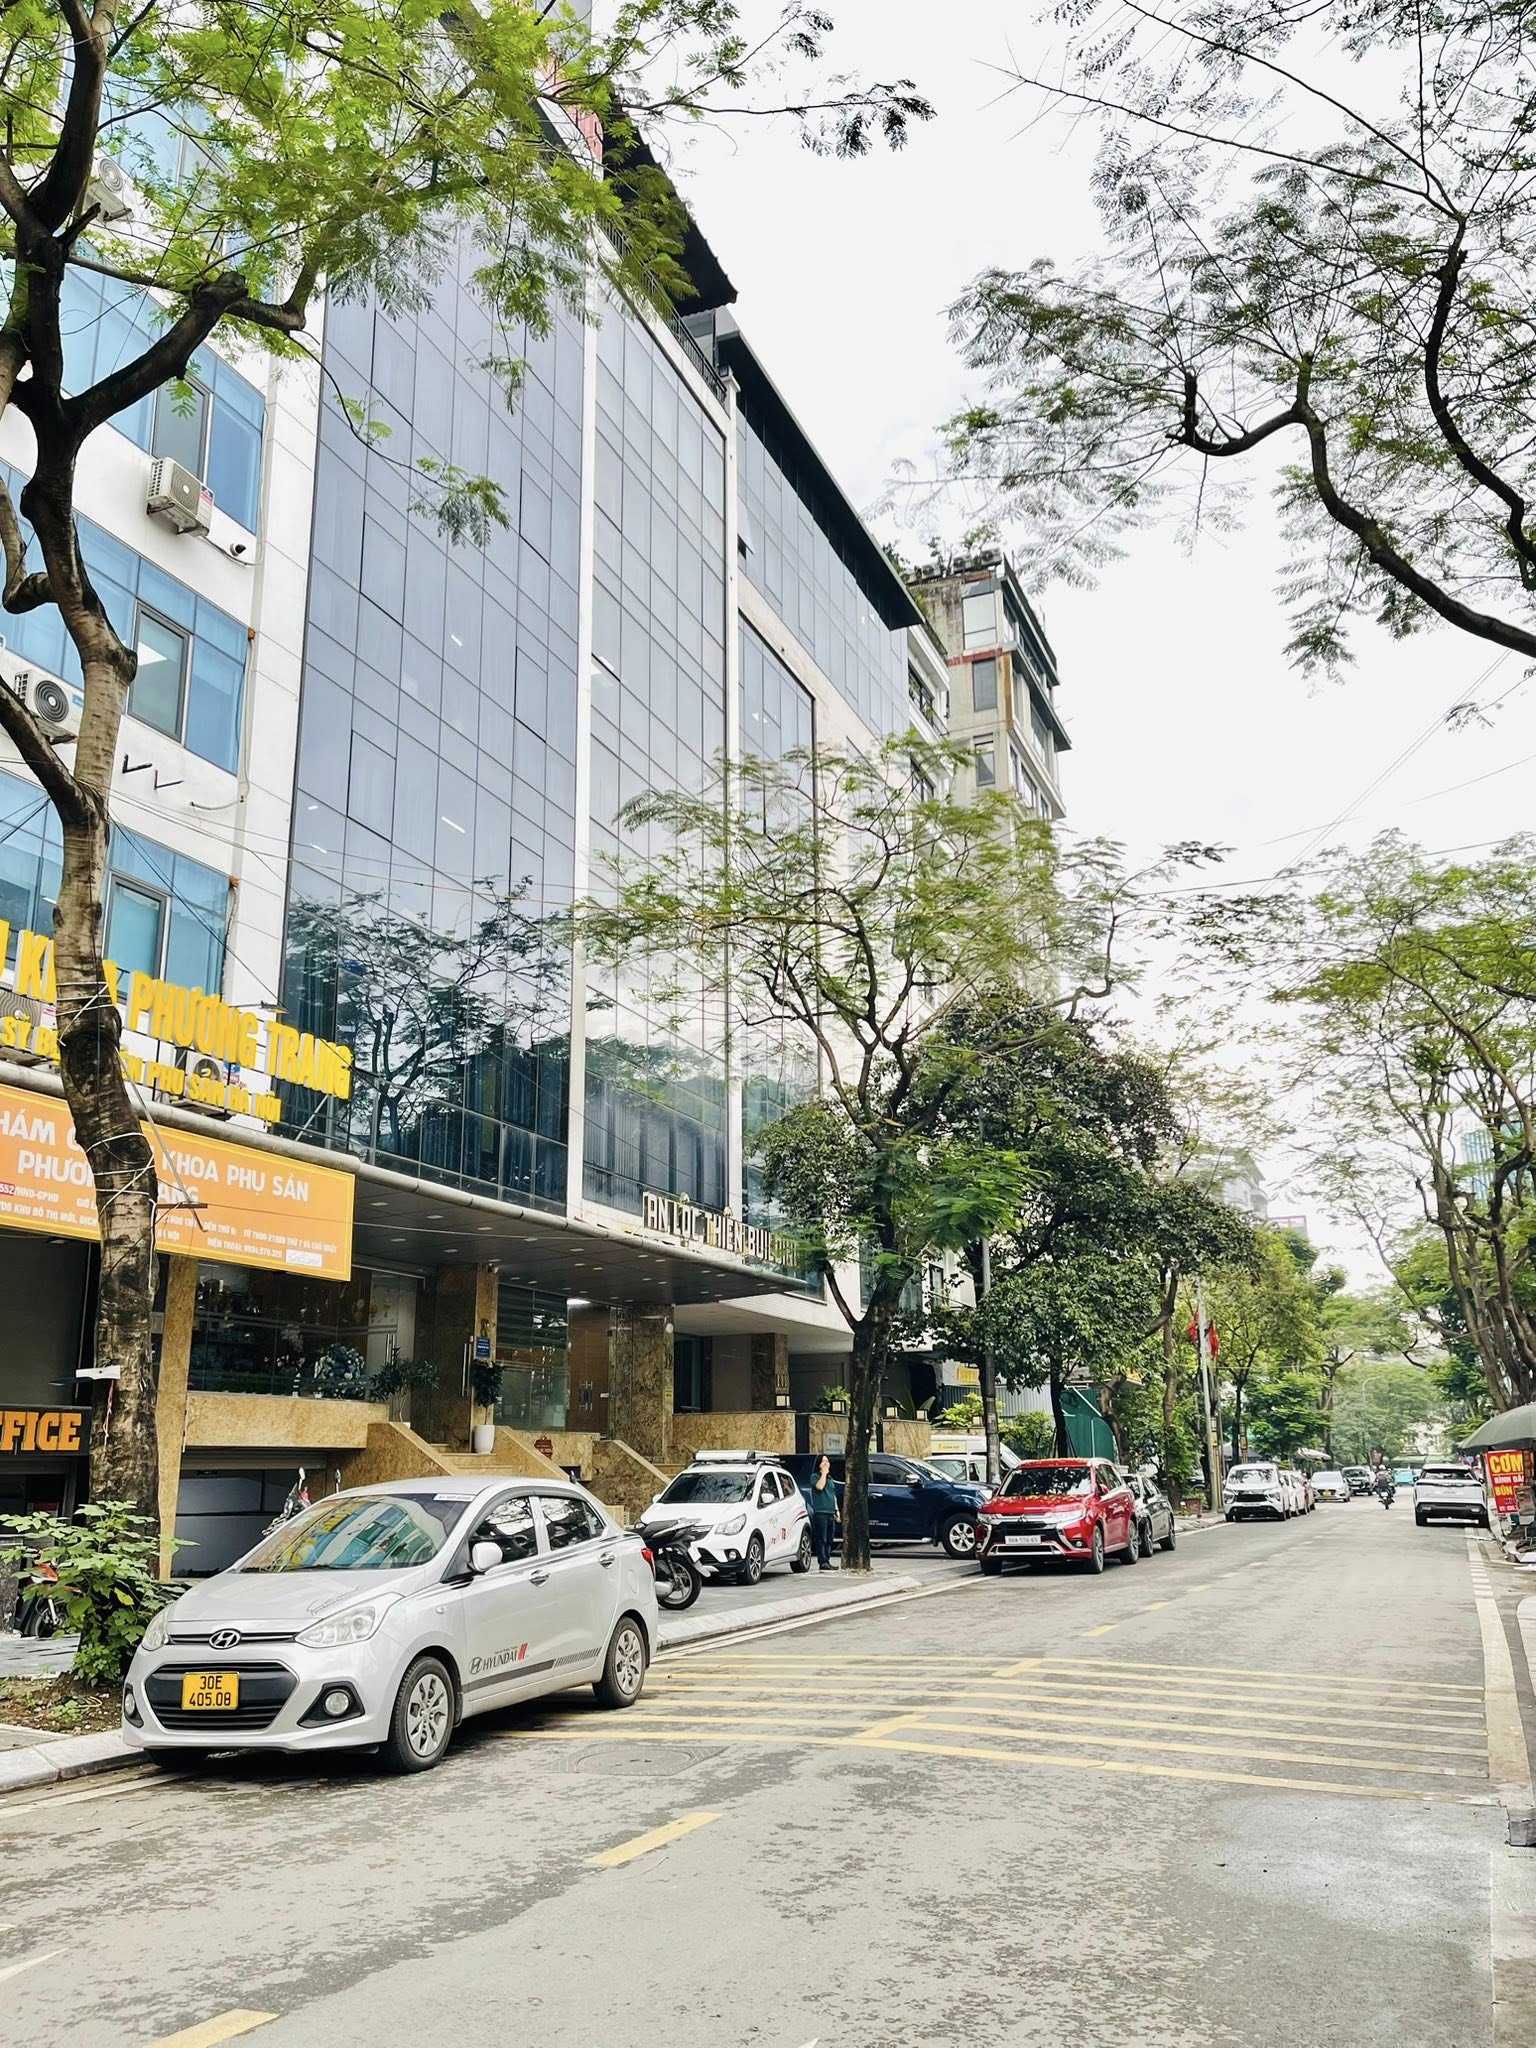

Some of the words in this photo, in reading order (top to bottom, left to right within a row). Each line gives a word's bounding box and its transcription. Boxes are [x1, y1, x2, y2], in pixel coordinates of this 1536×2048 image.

[128, 970, 259, 1068] PHƯƠNG
[266, 1019, 351, 1100] TRANG
[145, 1059, 185, 1100] PHỤ
[187, 1068, 226, 1108] SẢN
[162, 1150, 219, 1183] KHOA
[226, 1164, 266, 1196] PHỤ
[271, 1174, 309, 1202] SẢN
[643, 1191, 669, 1233] AN
[0, 1410, 82, 1451] FICE
[1489, 1453, 1524, 1474] CƠM
[482, 1650, 518, 1671] HYUNDAI
[189, 1692, 232, 1707] 405.08
[199, 1675, 223, 1690] 30E
